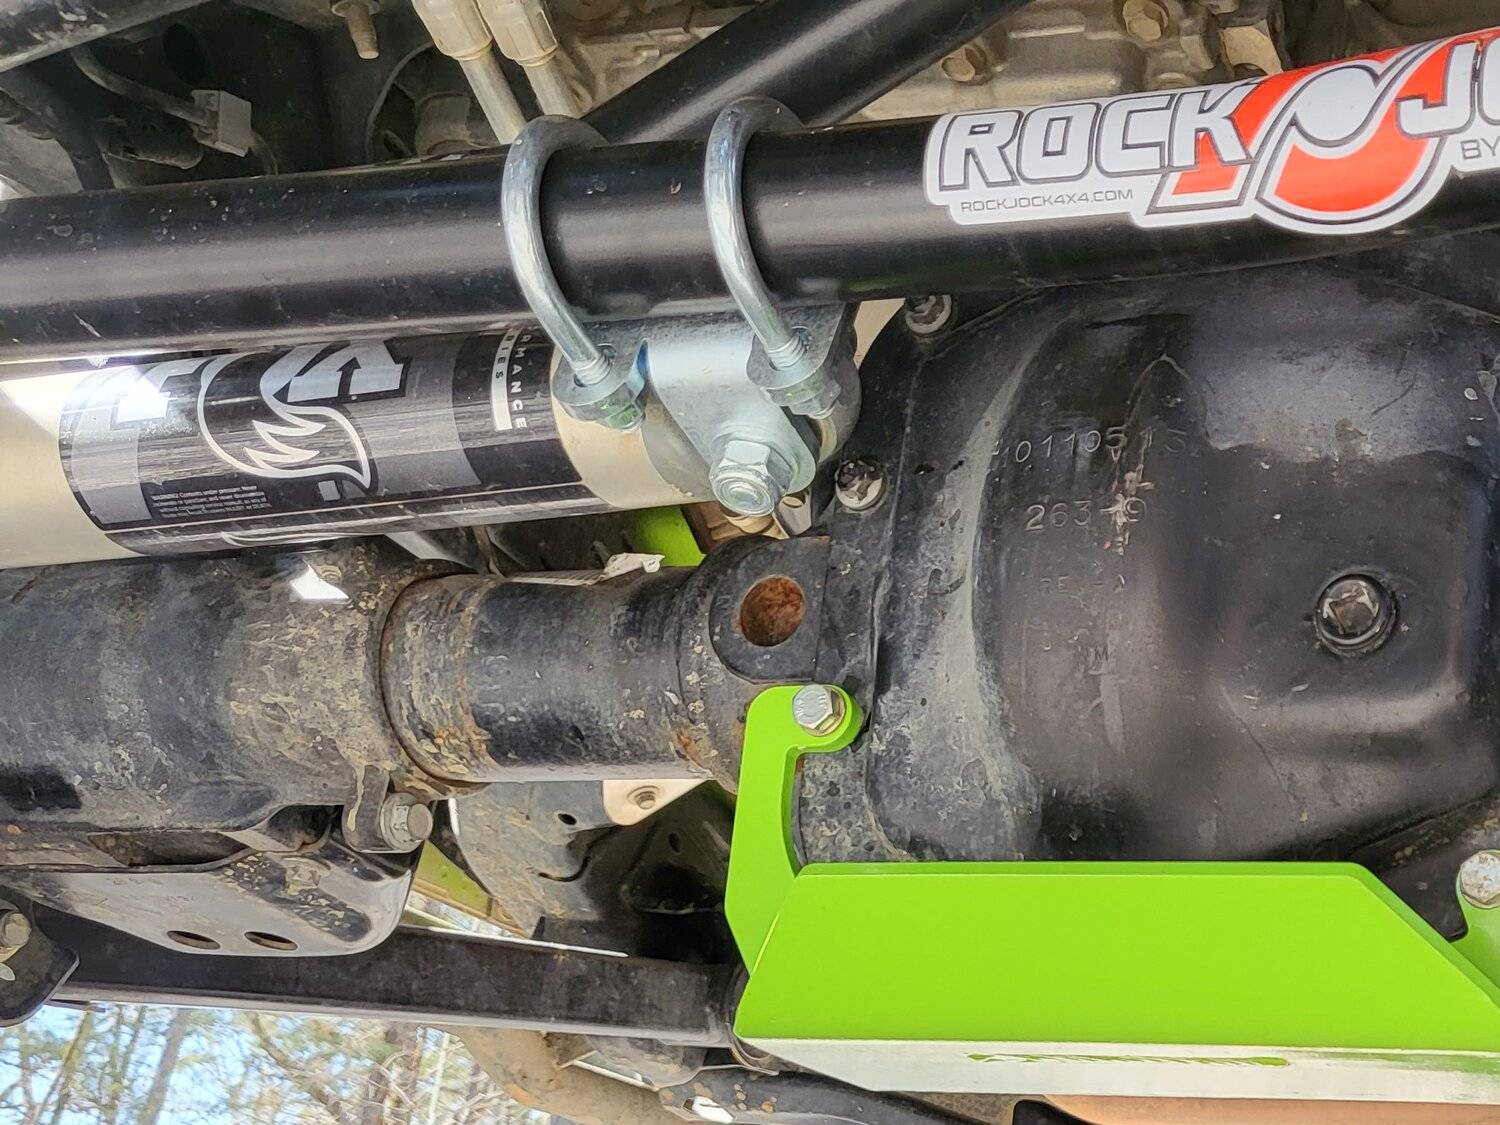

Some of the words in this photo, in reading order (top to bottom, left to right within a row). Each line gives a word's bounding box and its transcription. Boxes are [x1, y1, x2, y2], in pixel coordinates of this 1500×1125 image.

[938, 82, 1264, 191] ROCK
[1460, 135, 1500, 160] BY
[960, 189, 1134, 213] ROCKJOCK4X4.COM
